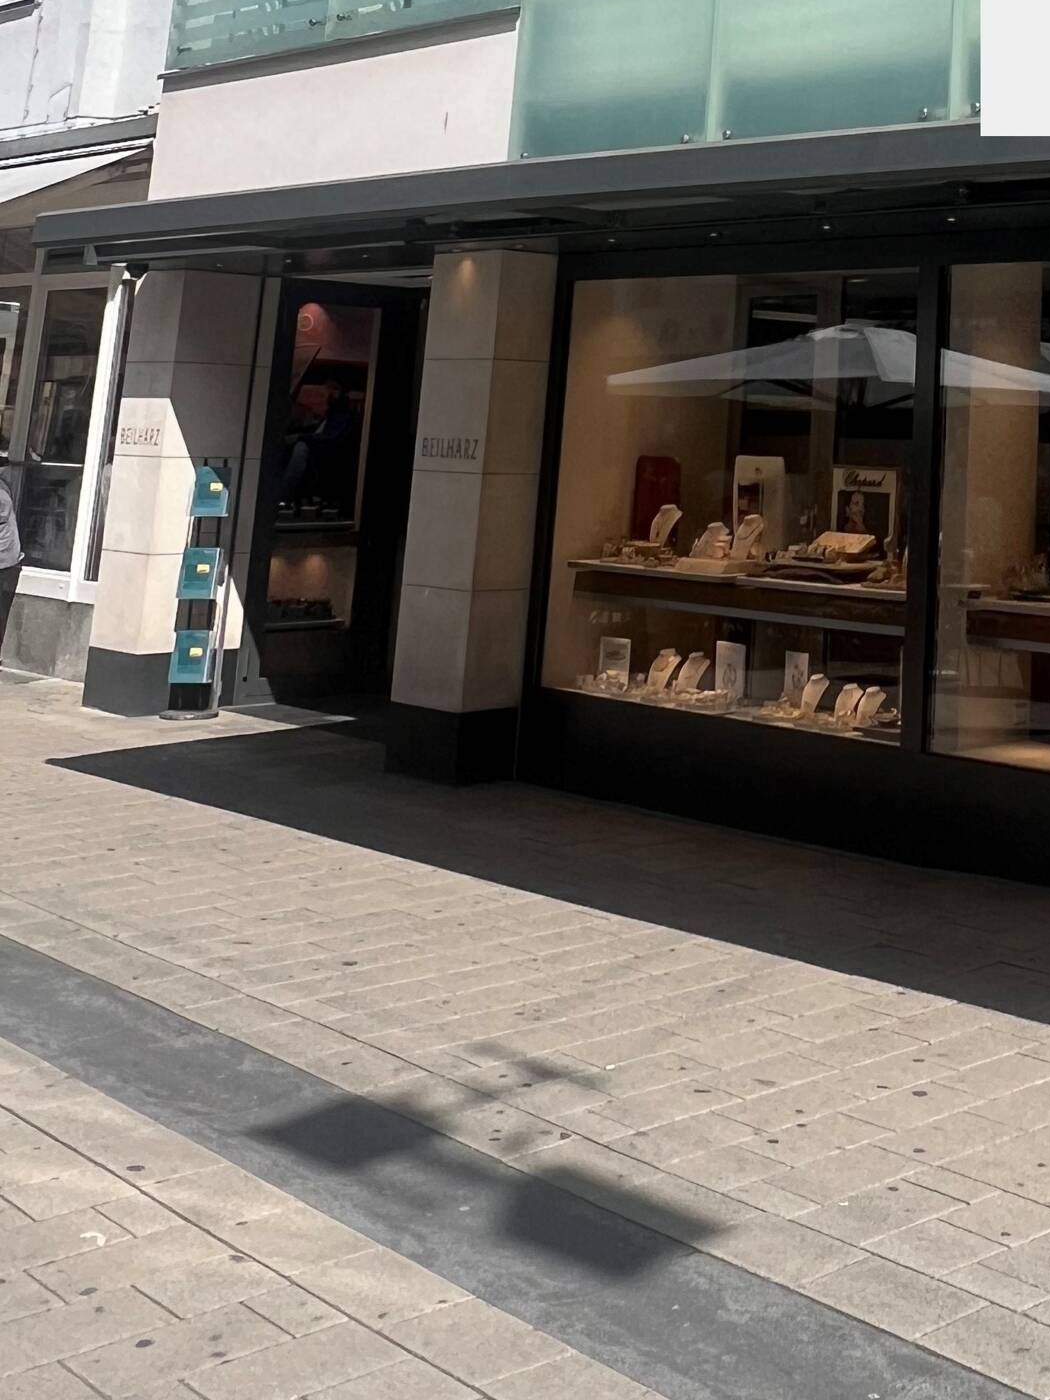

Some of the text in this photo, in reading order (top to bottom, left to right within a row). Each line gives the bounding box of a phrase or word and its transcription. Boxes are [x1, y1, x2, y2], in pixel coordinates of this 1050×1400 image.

[120, 427, 161, 447] BEILHARZ
[421, 437, 479, 460] BEILHARZ
[843, 469, 887, 488] Chopard
